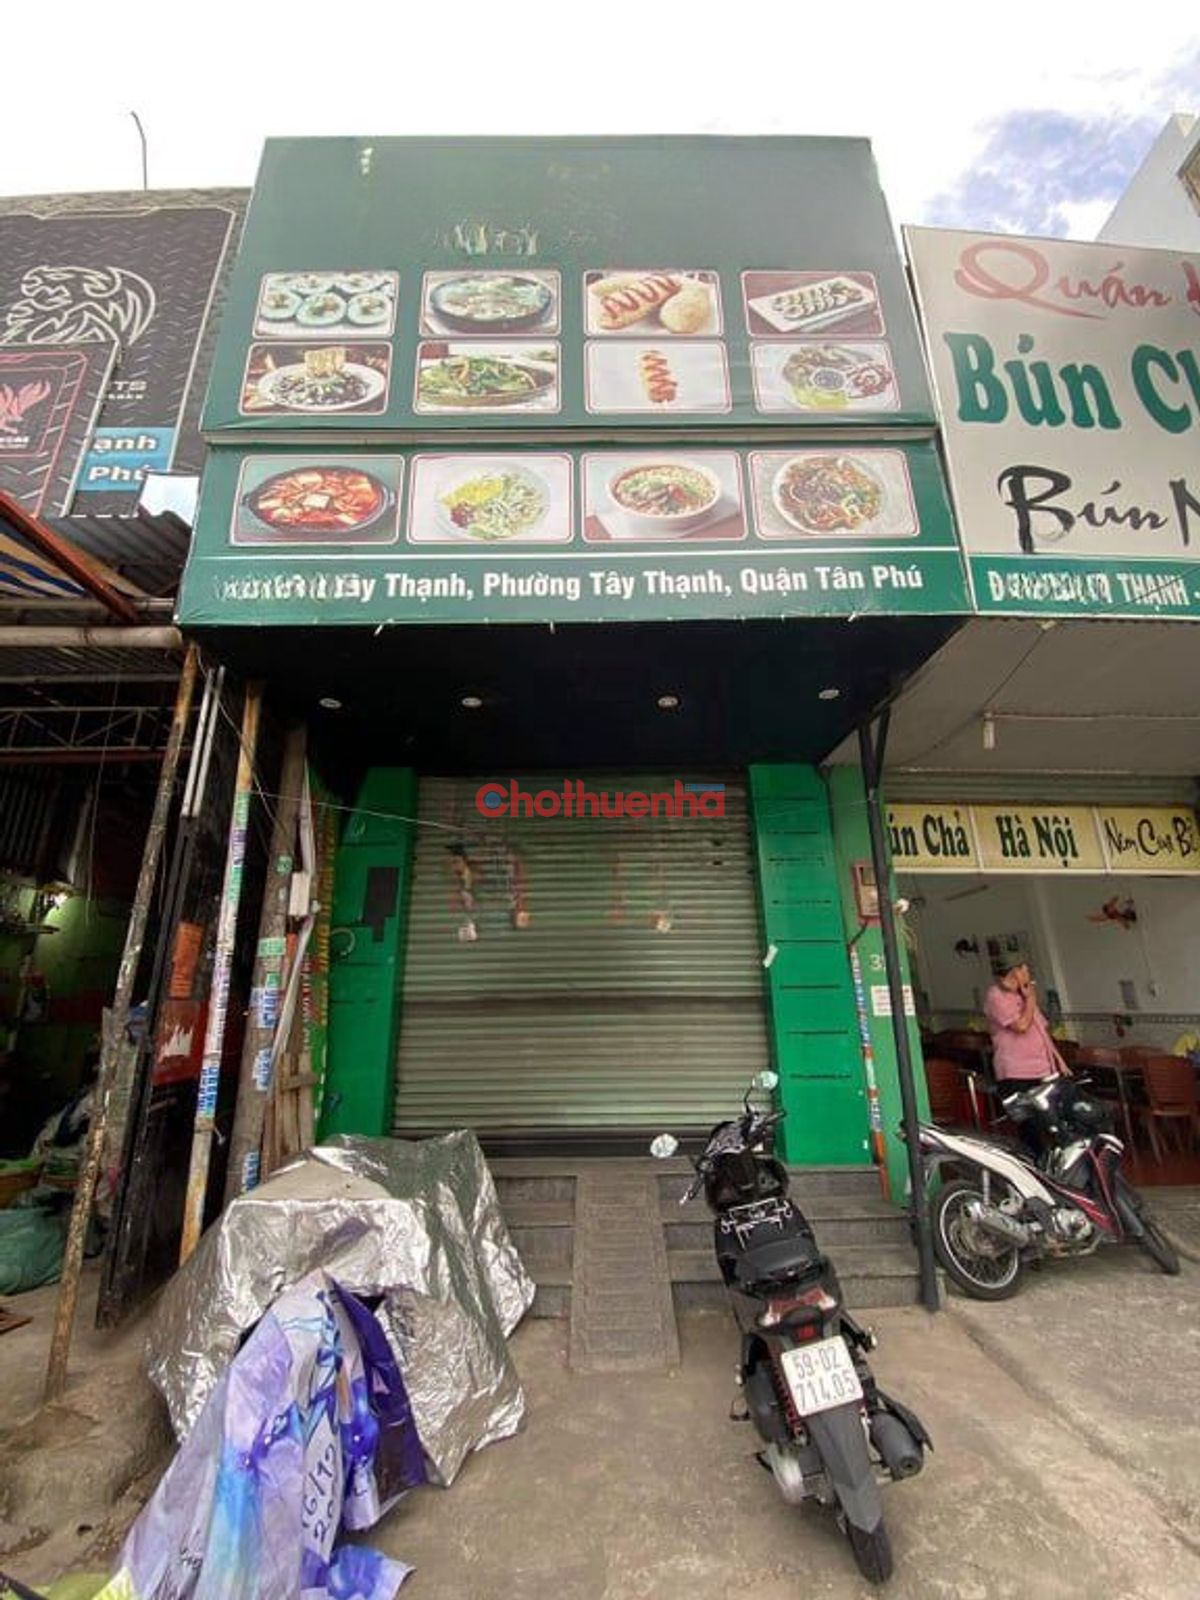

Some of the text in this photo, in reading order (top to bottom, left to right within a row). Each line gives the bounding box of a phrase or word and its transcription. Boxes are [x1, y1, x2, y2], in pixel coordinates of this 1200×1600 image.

[955, 240, 1171, 320] Quán
[943, 333, 1122, 430] Bún
[998, 465, 1168, 554] Bún
[384, 573, 474, 602] Thạnh,
[483, 572, 580, 603] Phường
[590, 570, 635, 600] Tây
[643, 570, 732, 600] Thạnh,
[741, 567, 807, 596] Quận
[815, 566, 864, 591] Tân
[873, 564, 923, 589] Phú
[1117, 571, 1190, 612] THẠNH
[887, 811, 1079, 868] ún Chả Hà Nội
